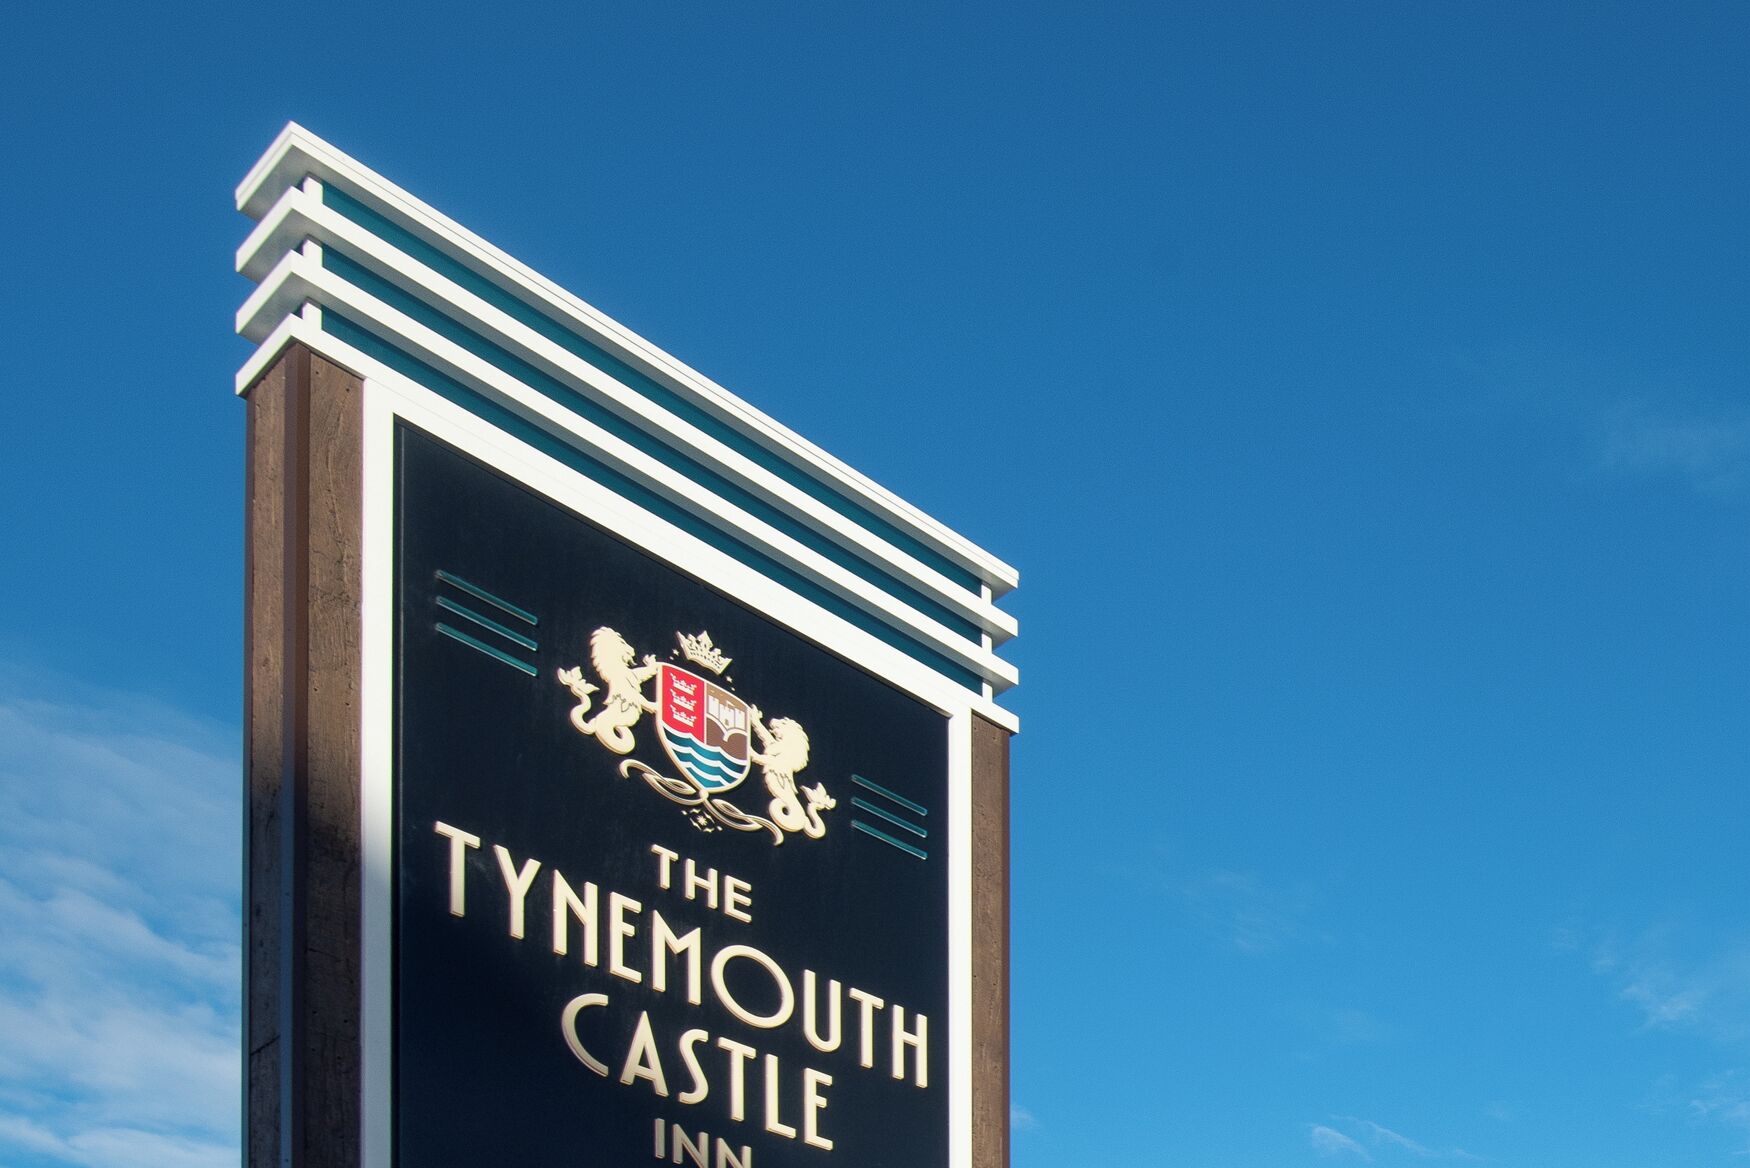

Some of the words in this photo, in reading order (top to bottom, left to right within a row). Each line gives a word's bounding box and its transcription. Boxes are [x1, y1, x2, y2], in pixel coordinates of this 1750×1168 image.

[434, 821, 928, 1088] TYNEMOUTH
[651, 844, 752, 923] THE
[561, 993, 833, 1150] CASTLE
